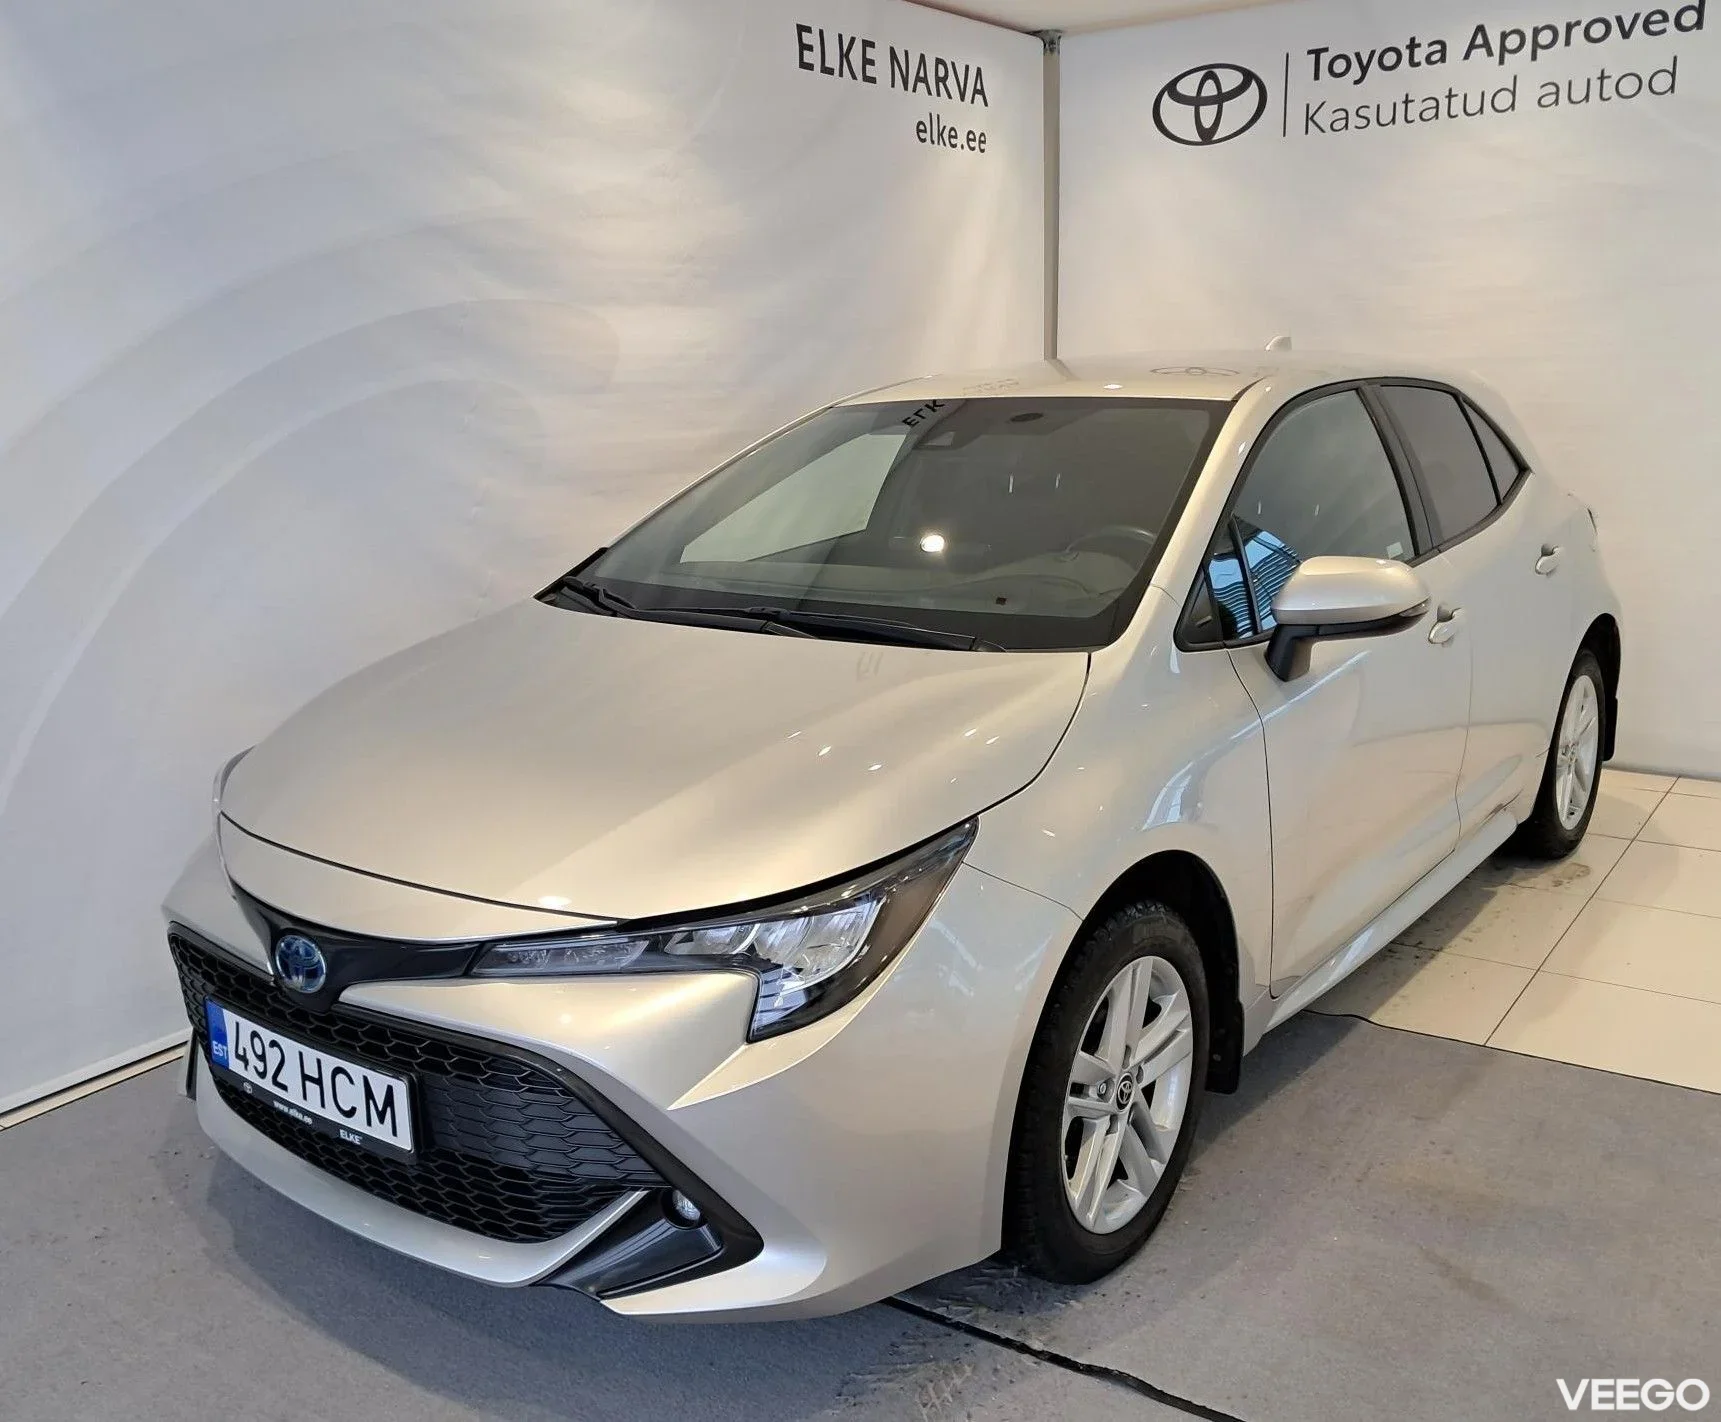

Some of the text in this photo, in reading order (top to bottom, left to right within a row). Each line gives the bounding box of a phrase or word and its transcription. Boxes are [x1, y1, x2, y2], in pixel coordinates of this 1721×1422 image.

[796, 23, 989, 108] ELKE NARVA
[1306, 0, 1706, 86] Toyota Approved
[915, 112, 987, 154] elke.ee
[1304, 55, 1678, 136] Kasutatud autod
[212, 1040, 228, 1060] EST
[234, 1021, 398, 1138] 492 HCM
[339, 1129, 361, 1145] ELKE
